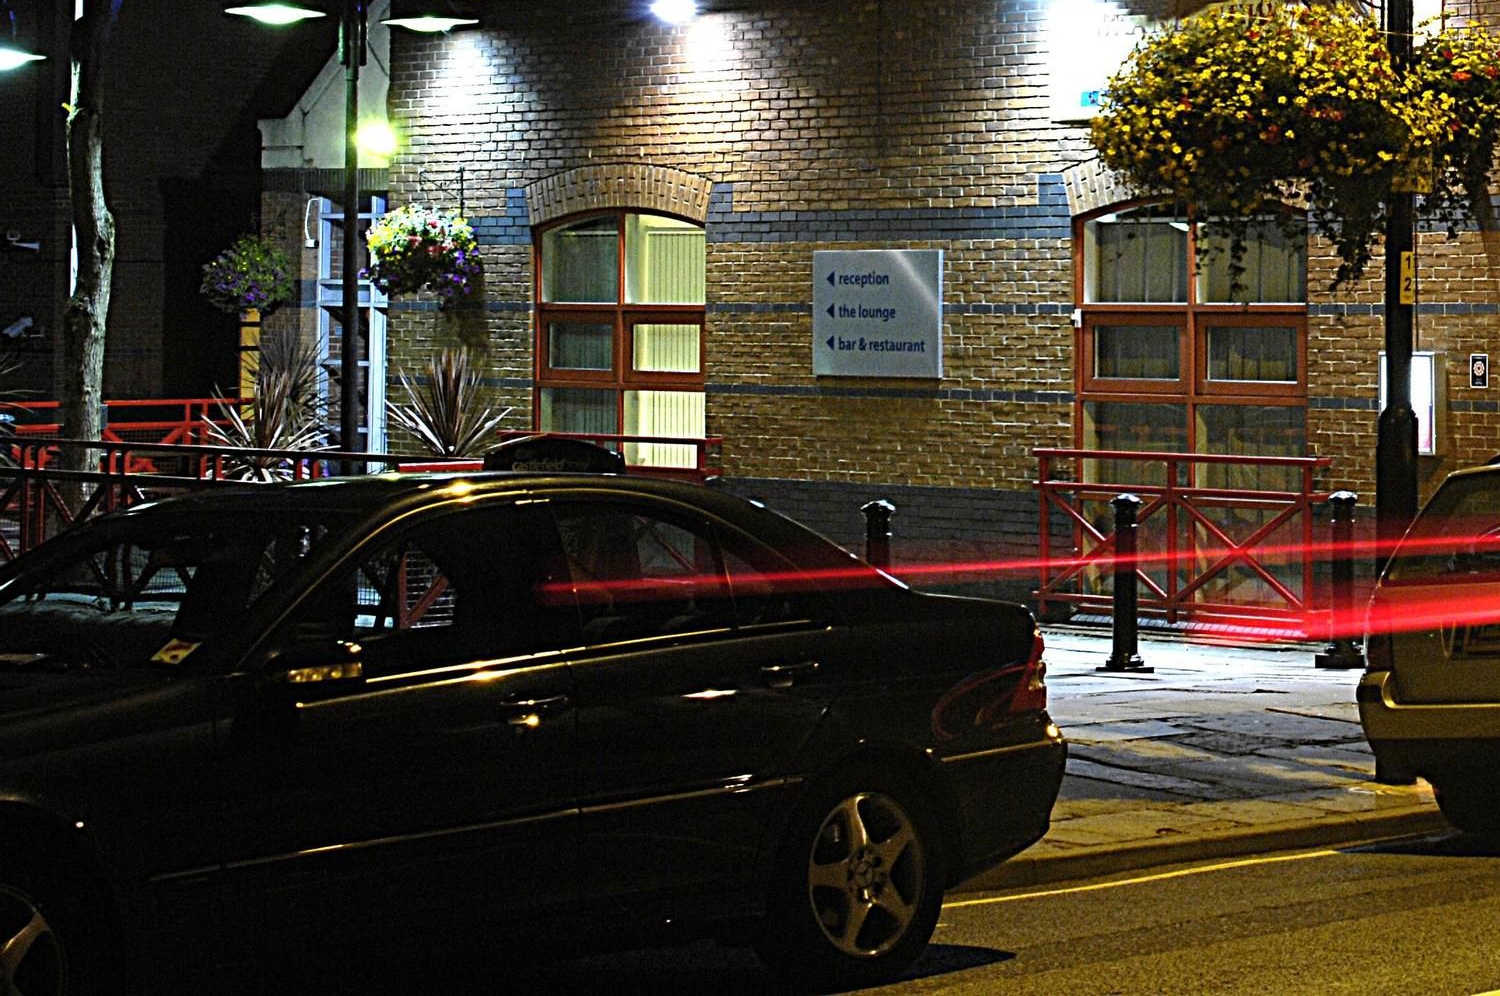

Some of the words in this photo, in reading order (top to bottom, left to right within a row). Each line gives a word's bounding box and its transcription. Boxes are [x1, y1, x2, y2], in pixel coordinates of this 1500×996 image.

[838, 270, 890, 288] reception
[838, 305, 856, 318] the
[858, 305, 896, 321] lounge
[838, 337, 856, 351] bar
[858, 338, 867, 351] &
[869, 340, 925, 352] restaurant
